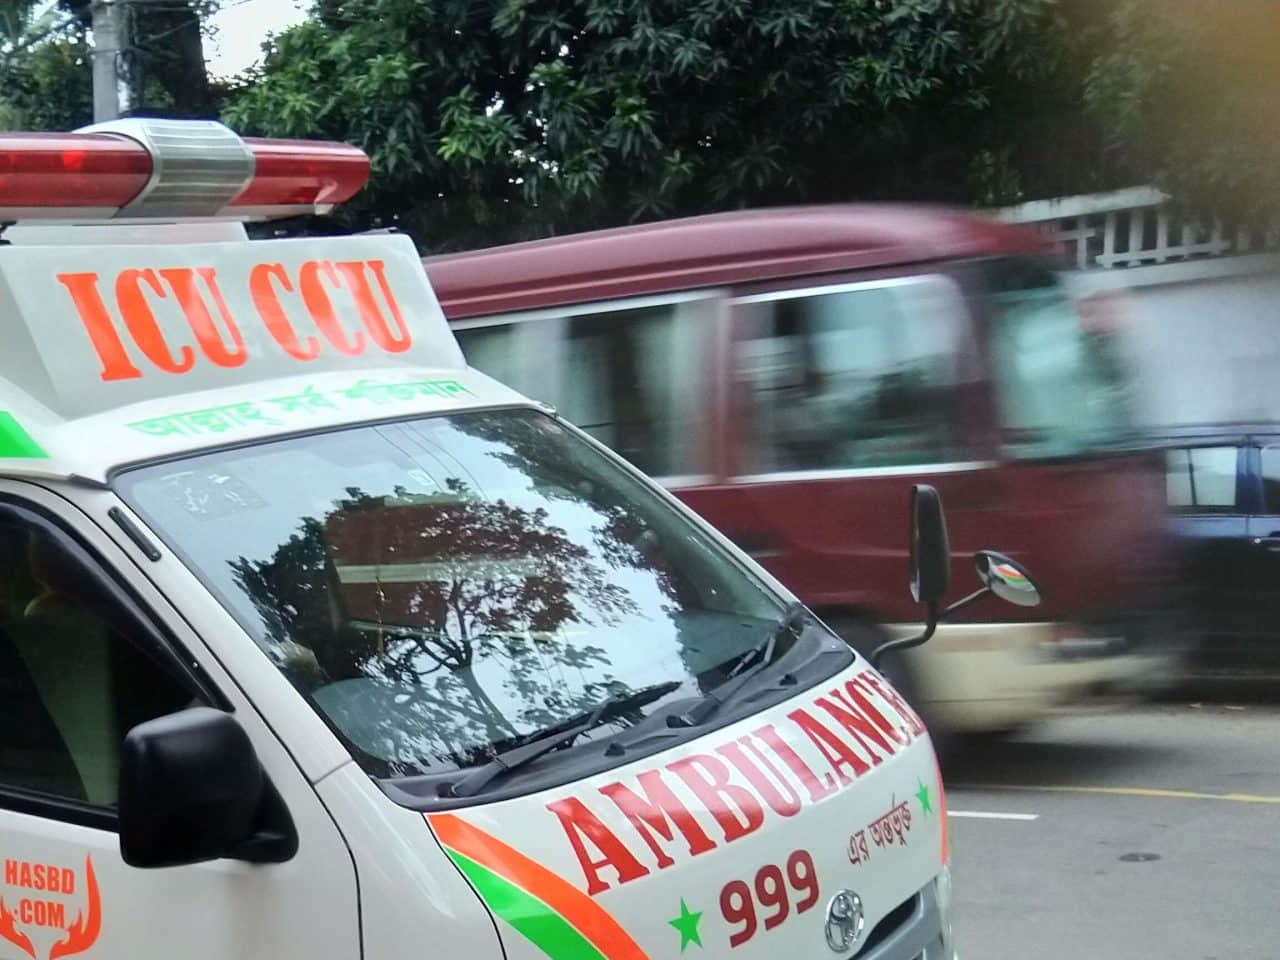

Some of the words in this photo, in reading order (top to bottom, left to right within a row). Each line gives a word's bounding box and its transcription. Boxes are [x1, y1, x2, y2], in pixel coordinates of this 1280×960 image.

[57, 262, 248, 381] ICU
[249, 259, 412, 363] CCU
[546, 669, 927, 897] AMBULANCE
[4, 859, 75, 895] HASBD
[720, 849, 819, 948] 999
